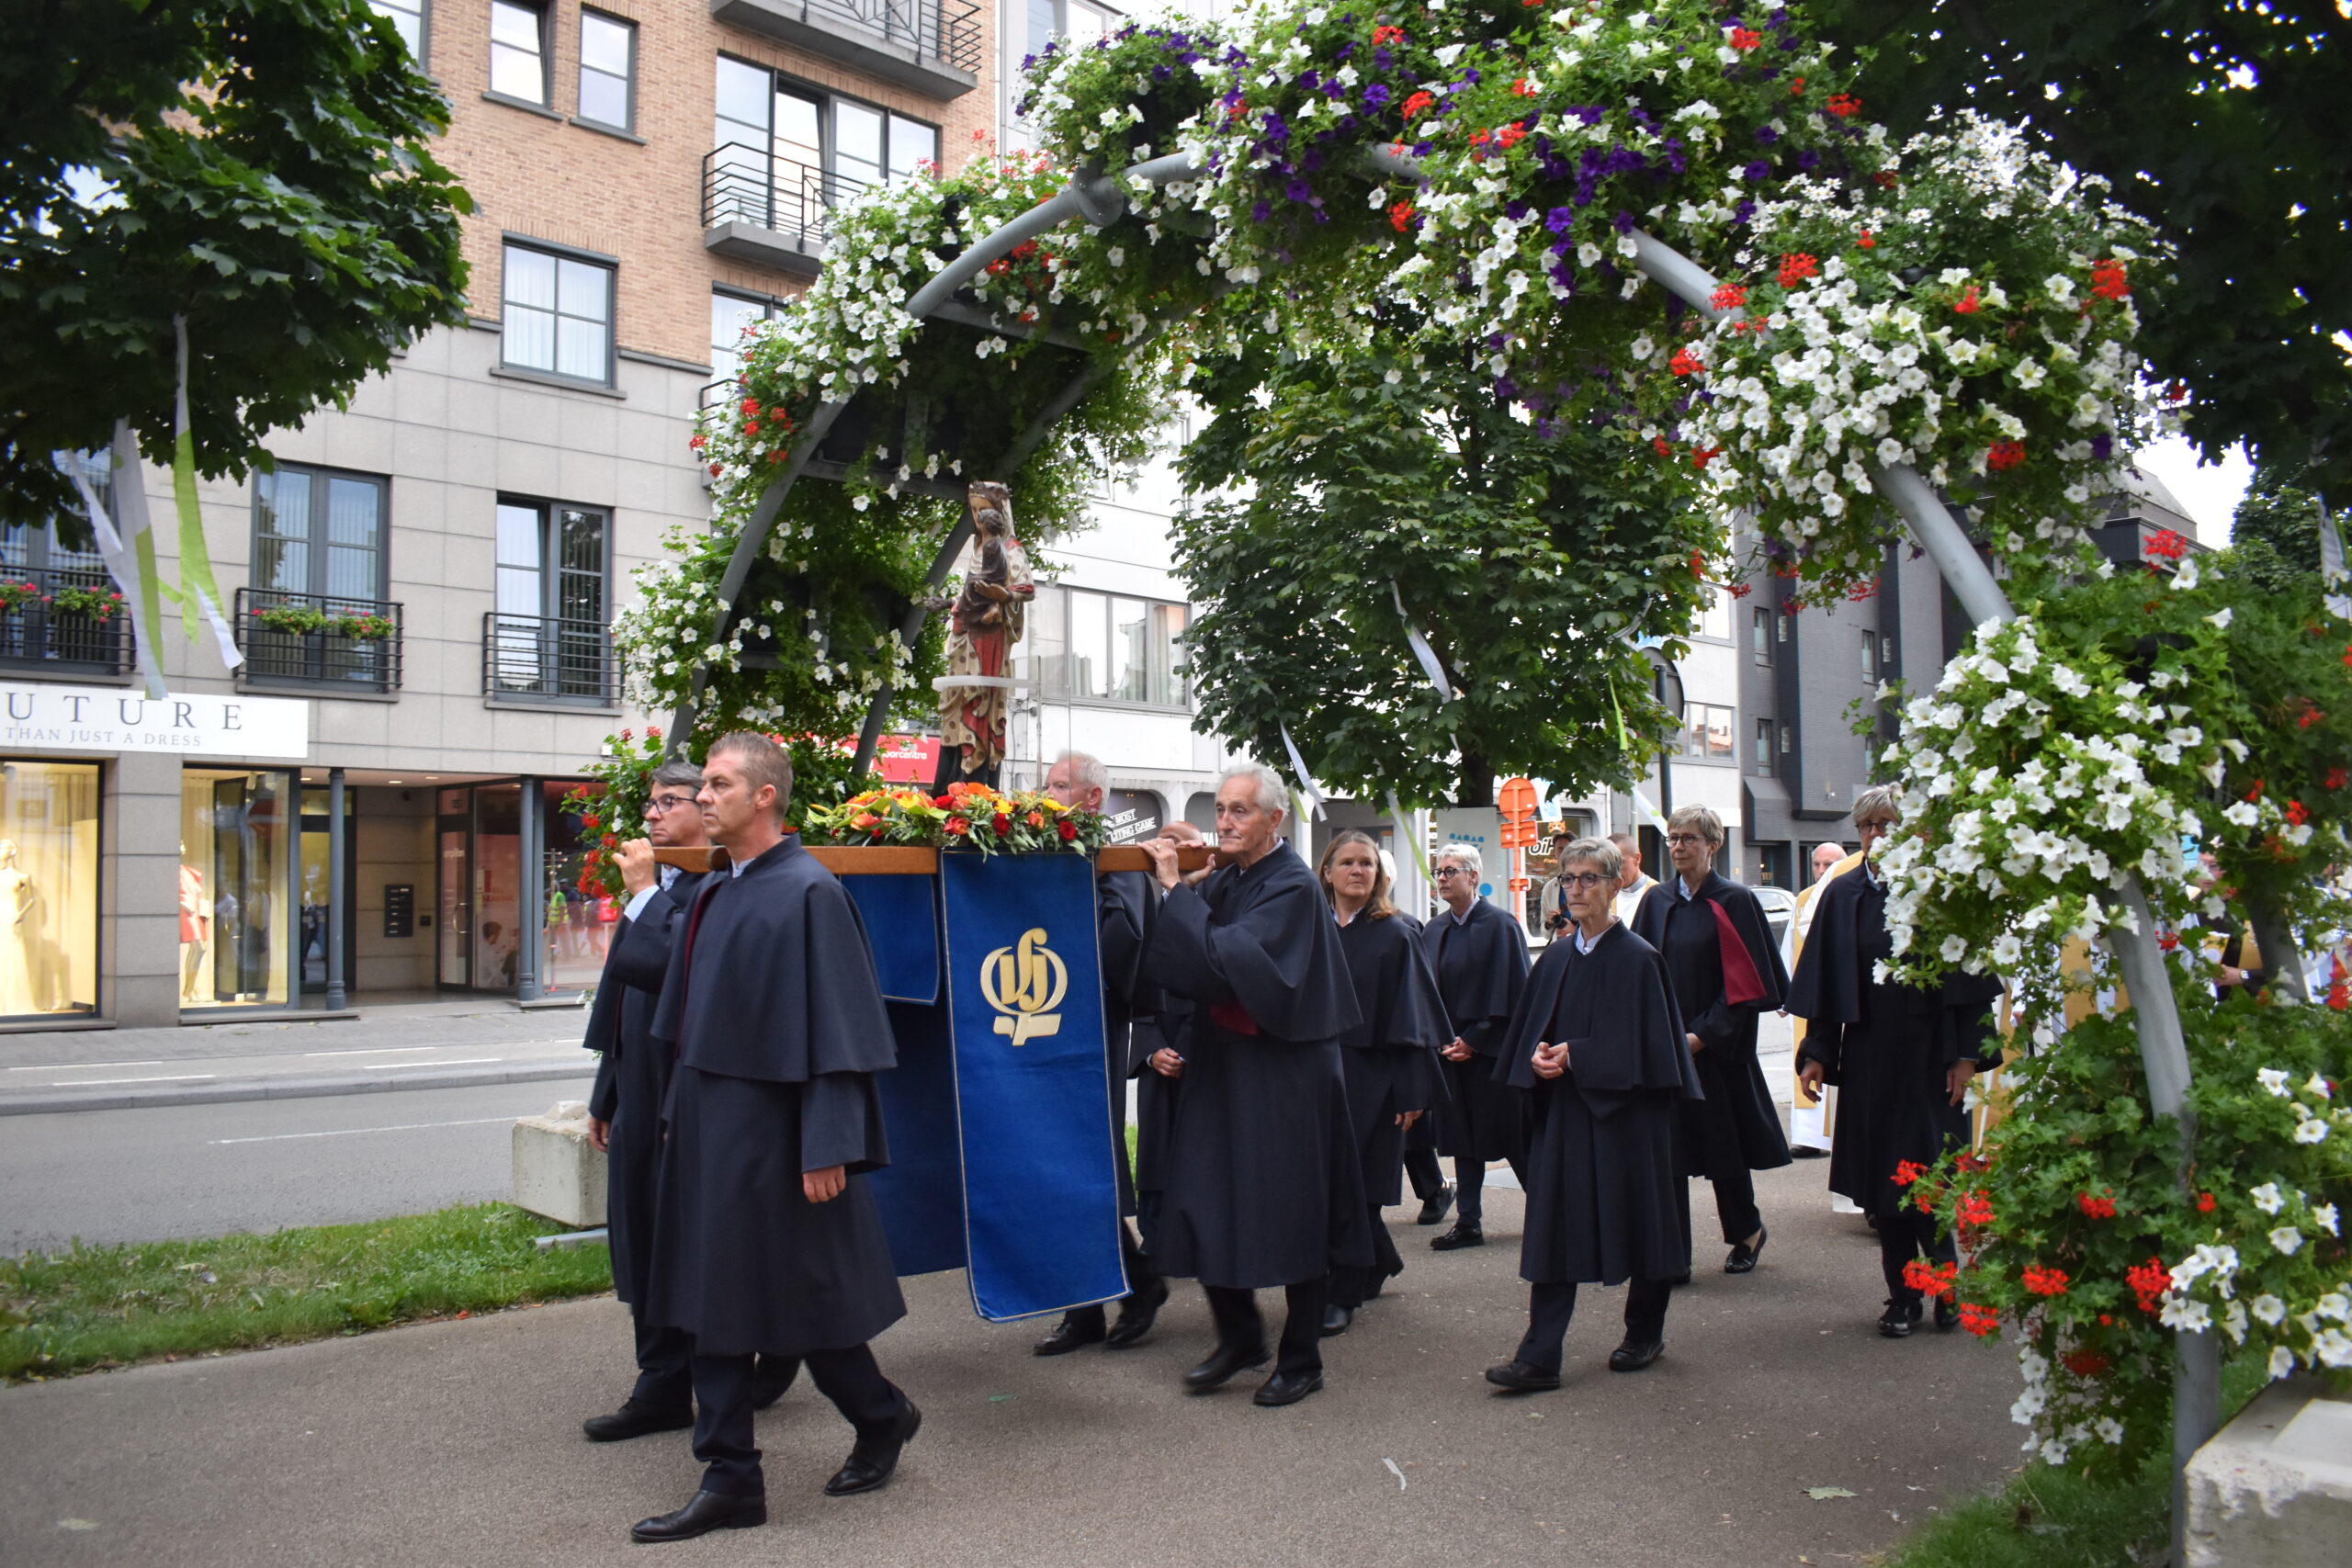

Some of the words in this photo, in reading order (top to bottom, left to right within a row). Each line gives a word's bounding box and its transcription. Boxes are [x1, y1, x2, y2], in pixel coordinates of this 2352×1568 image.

[6, 692, 243, 730] UTURE
[6, 727, 60, 740] THAN
[68, 730, 114, 743] JUST
[123, 732, 134, 744] A
[144, 733, 200, 747] DRESS
[881, 750, 927, 760] oorcentra
[1114, 808, 1136, 826] MOST
[1134, 818, 1156, 833] GAME
